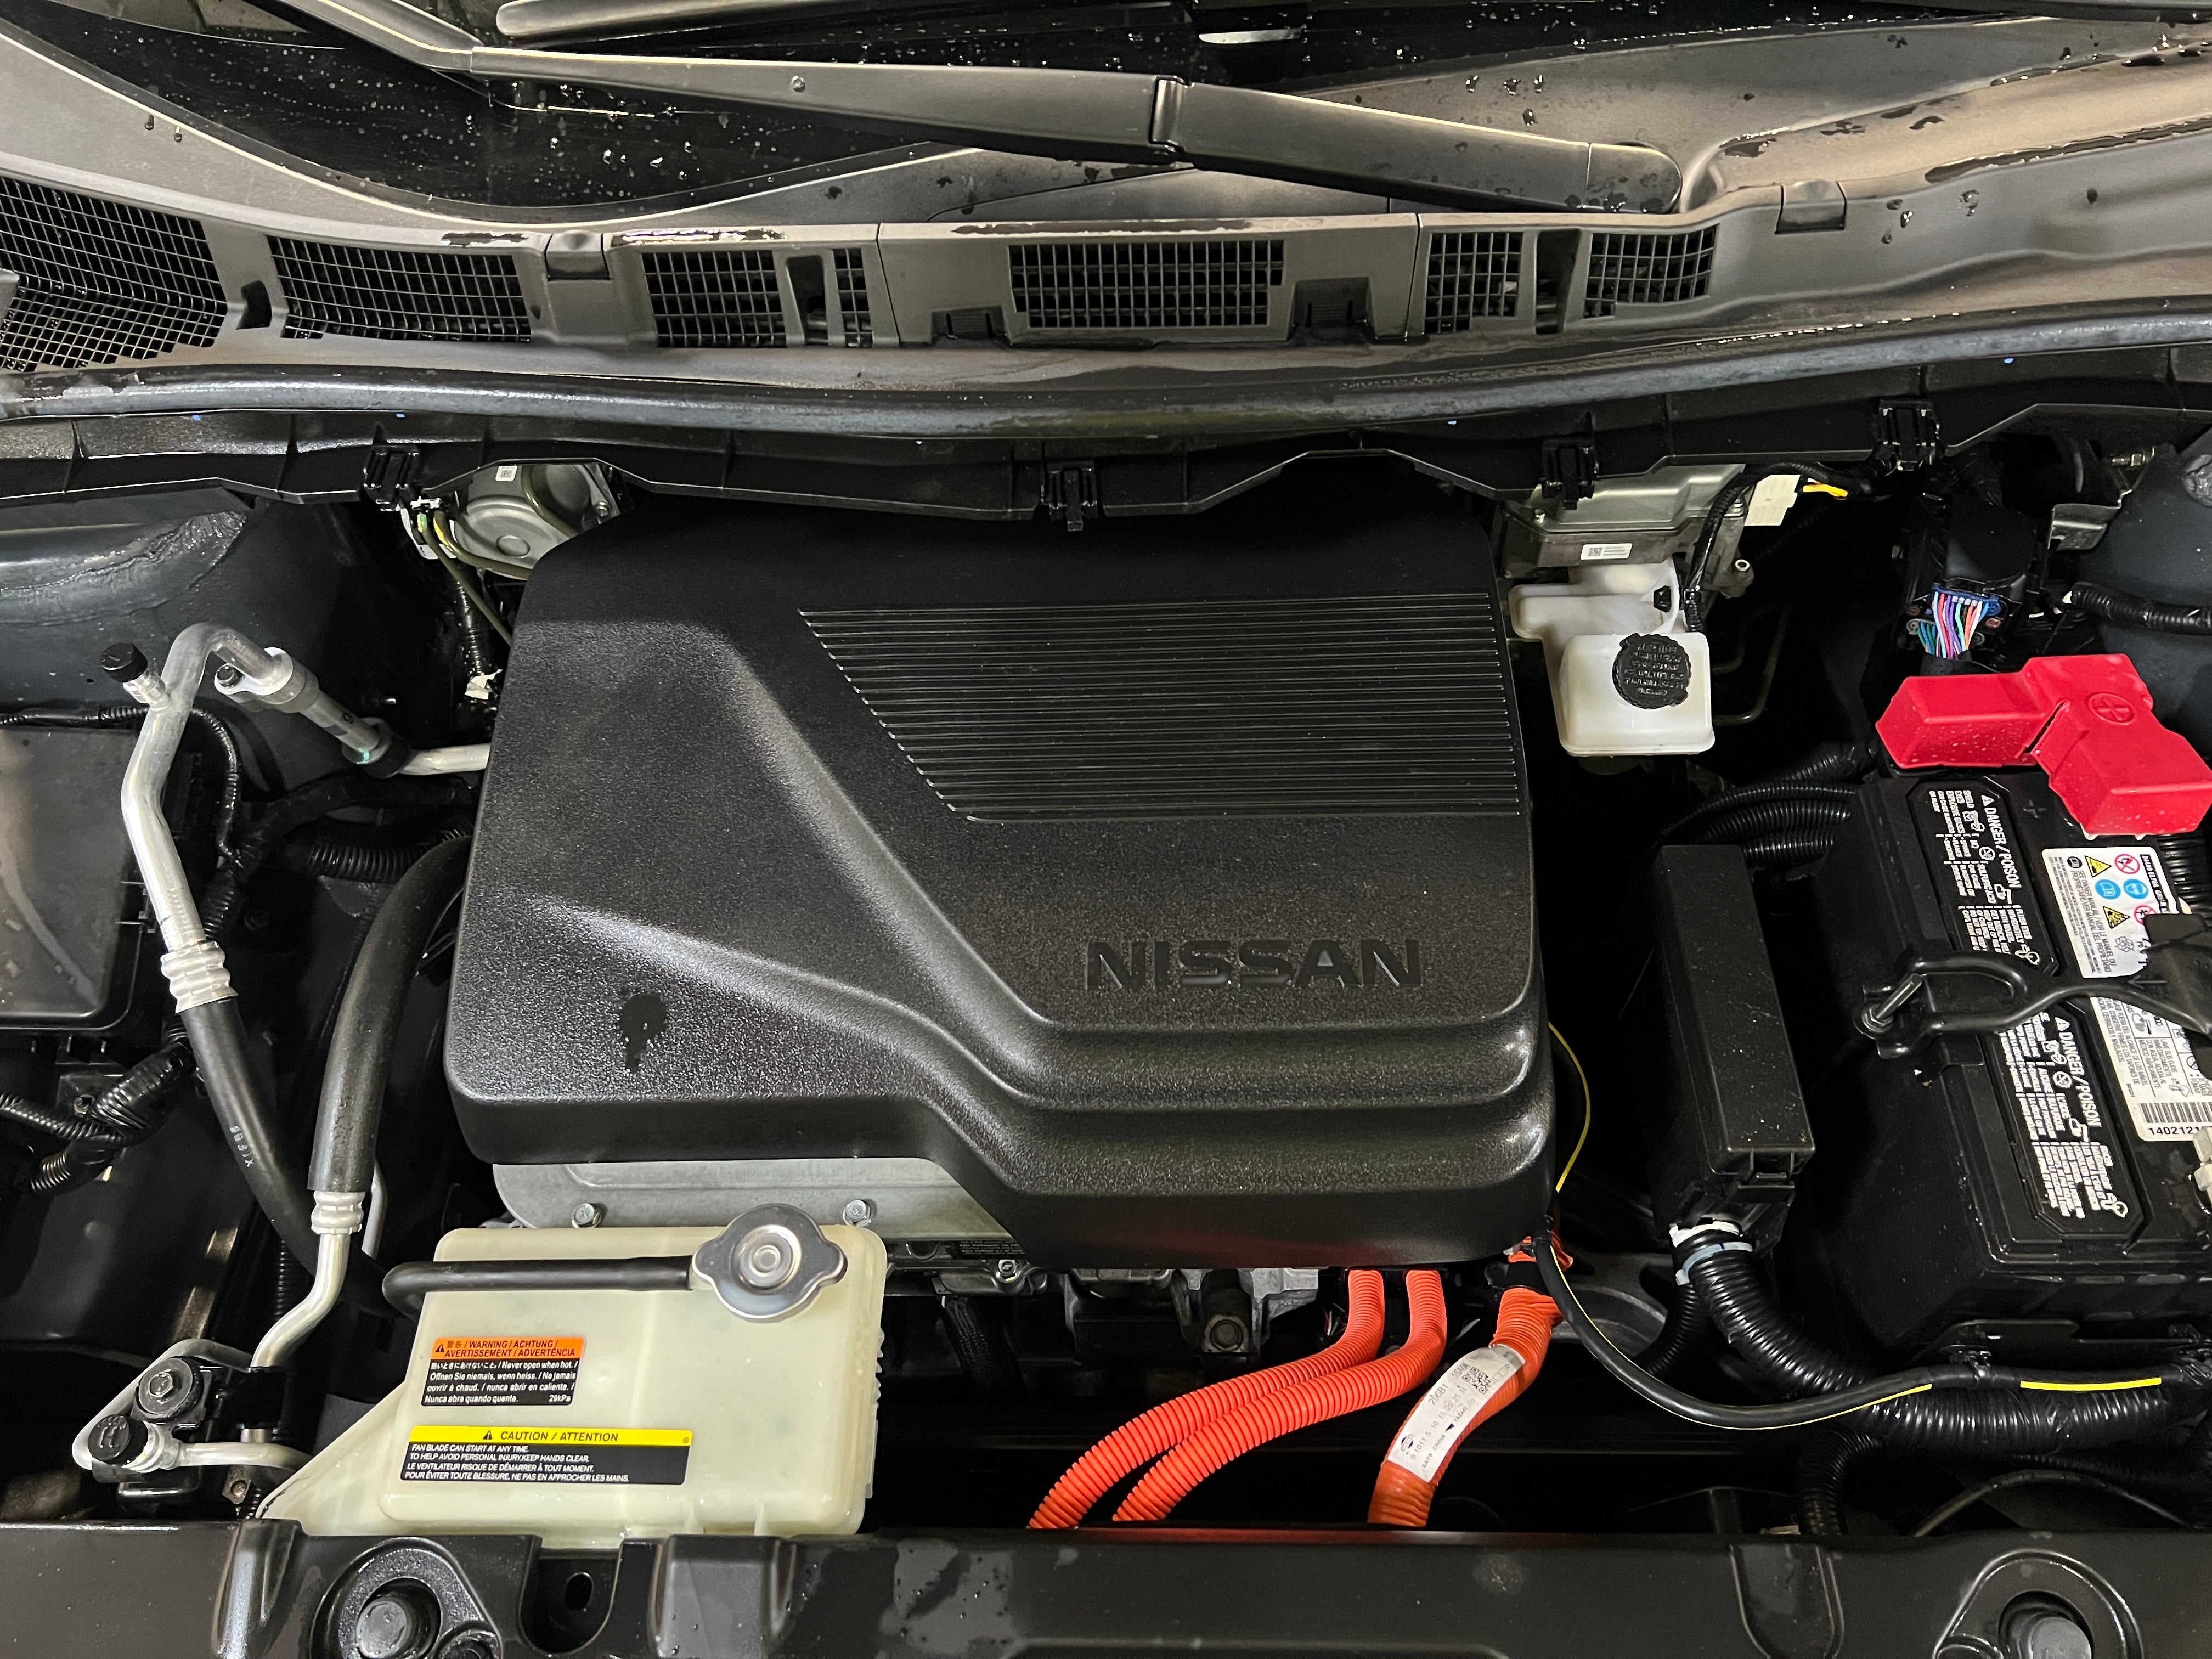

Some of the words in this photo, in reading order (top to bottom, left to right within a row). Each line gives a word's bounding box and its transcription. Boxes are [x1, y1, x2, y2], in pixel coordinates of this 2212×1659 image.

[1085, 938, 1423, 988] NISSAN
[513, 1340, 553, 1348] ACHTUNG
[444, 1349, 512, 1357] AVERTISSEMENT
[523, 1362, 540, 1370] open
[454, 1372, 466, 1380] Sie
[552, 1372, 577, 1381] jamais
[427, 1384, 448, 1392] ouvrir
[510, 1383, 527, 1391] abrir
[448, 1395, 465, 1403] abra
[465, 1394, 492, 1404] quando
[549, 1394, 571, 1402] 29kPa
[500, 1431, 548, 1441] CAUTION
[560, 1432, 618, 1442] ATTENTION
[499, 1462, 537, 1471] DÉMARRER
[425, 1470, 449, 1479] ÉVITER
